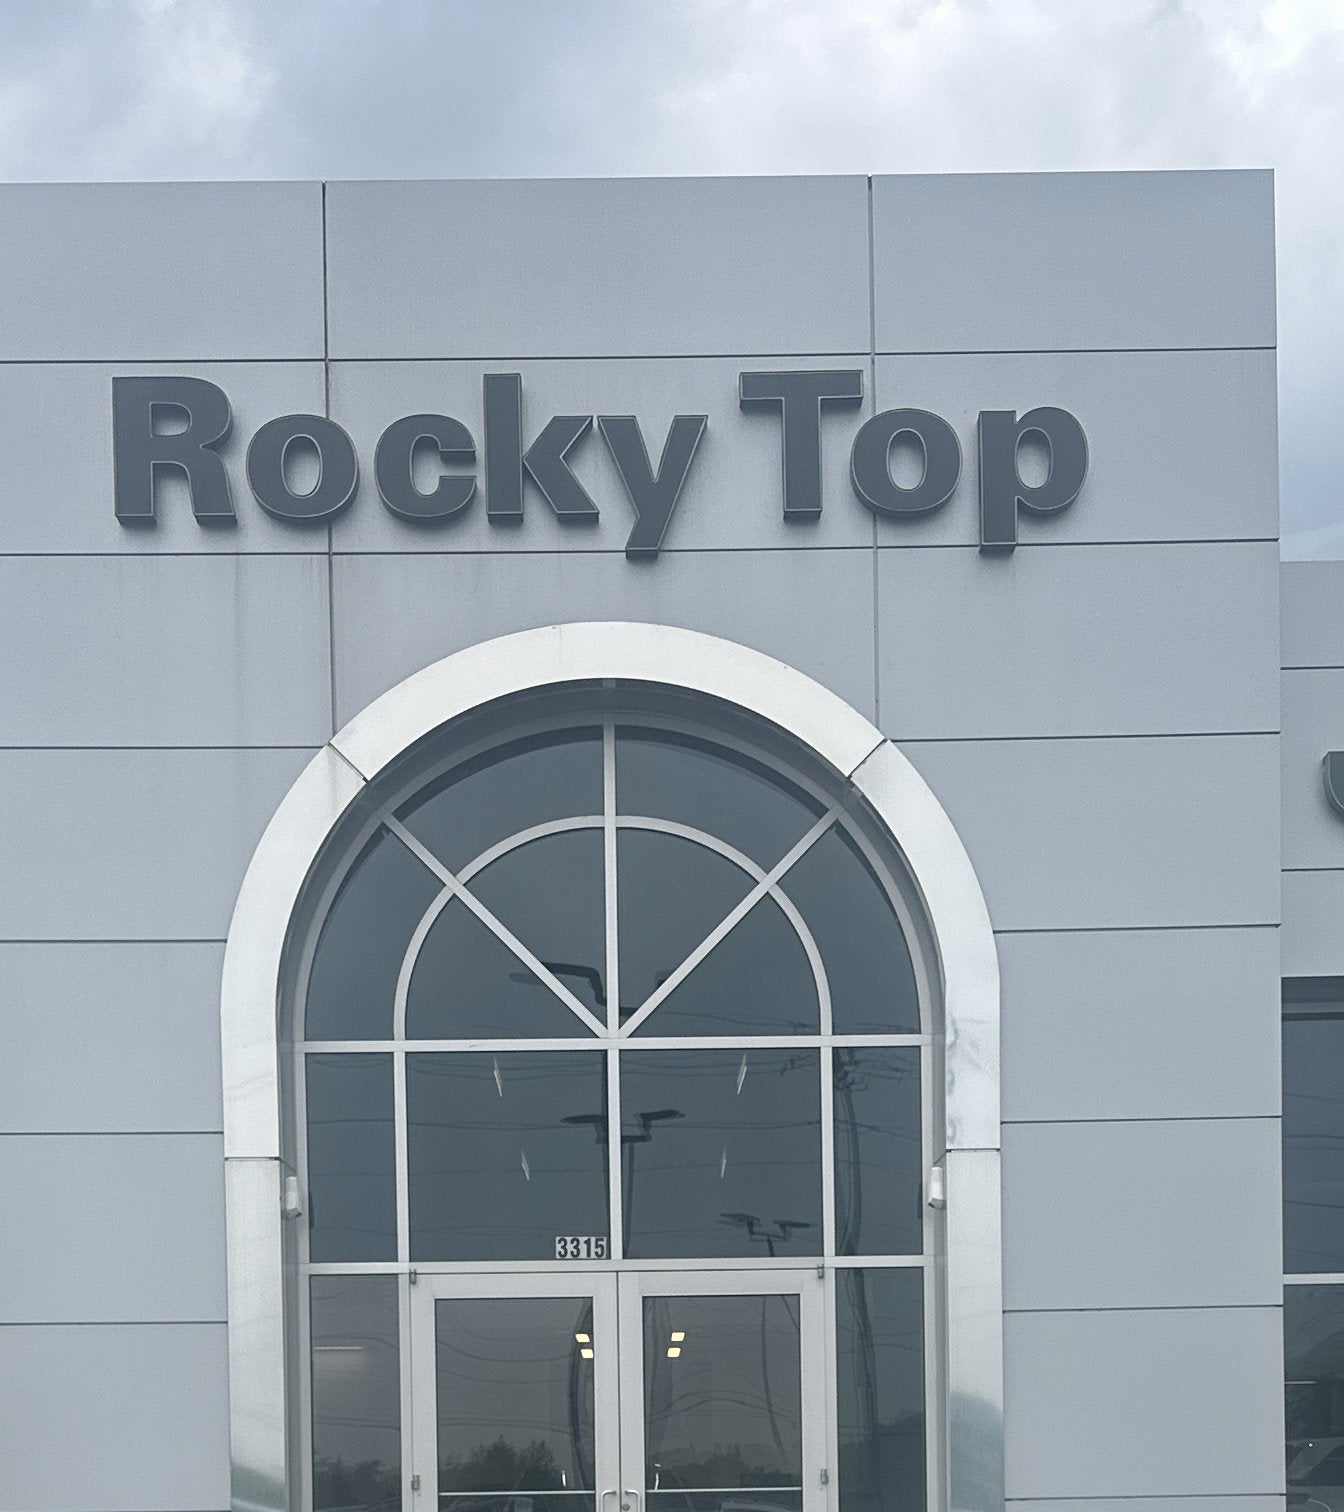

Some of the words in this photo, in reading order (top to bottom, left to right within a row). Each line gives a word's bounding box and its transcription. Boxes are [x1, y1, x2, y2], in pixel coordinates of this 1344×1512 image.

[112, 372, 708, 558] Rocky
[739, 369, 1089, 553] Top
[557, 1237, 605, 1258] 3315
